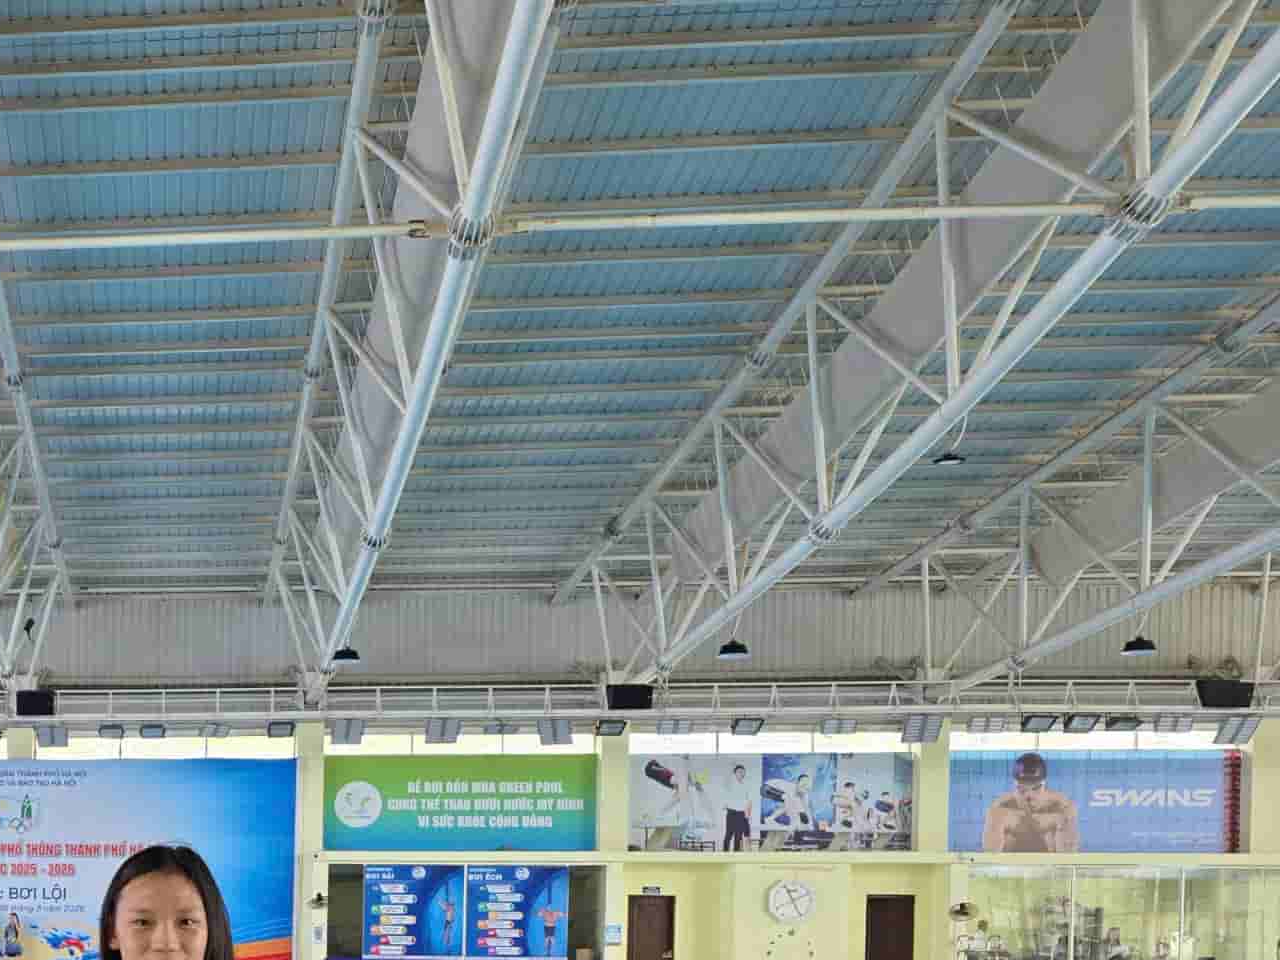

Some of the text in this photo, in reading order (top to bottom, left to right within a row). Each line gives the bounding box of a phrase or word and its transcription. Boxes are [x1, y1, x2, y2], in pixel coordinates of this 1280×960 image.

[1088, 788, 1217, 807] SWANS
[8, 887, 37, 900] BƠI
[42, 883, 67, 903] LỘI
